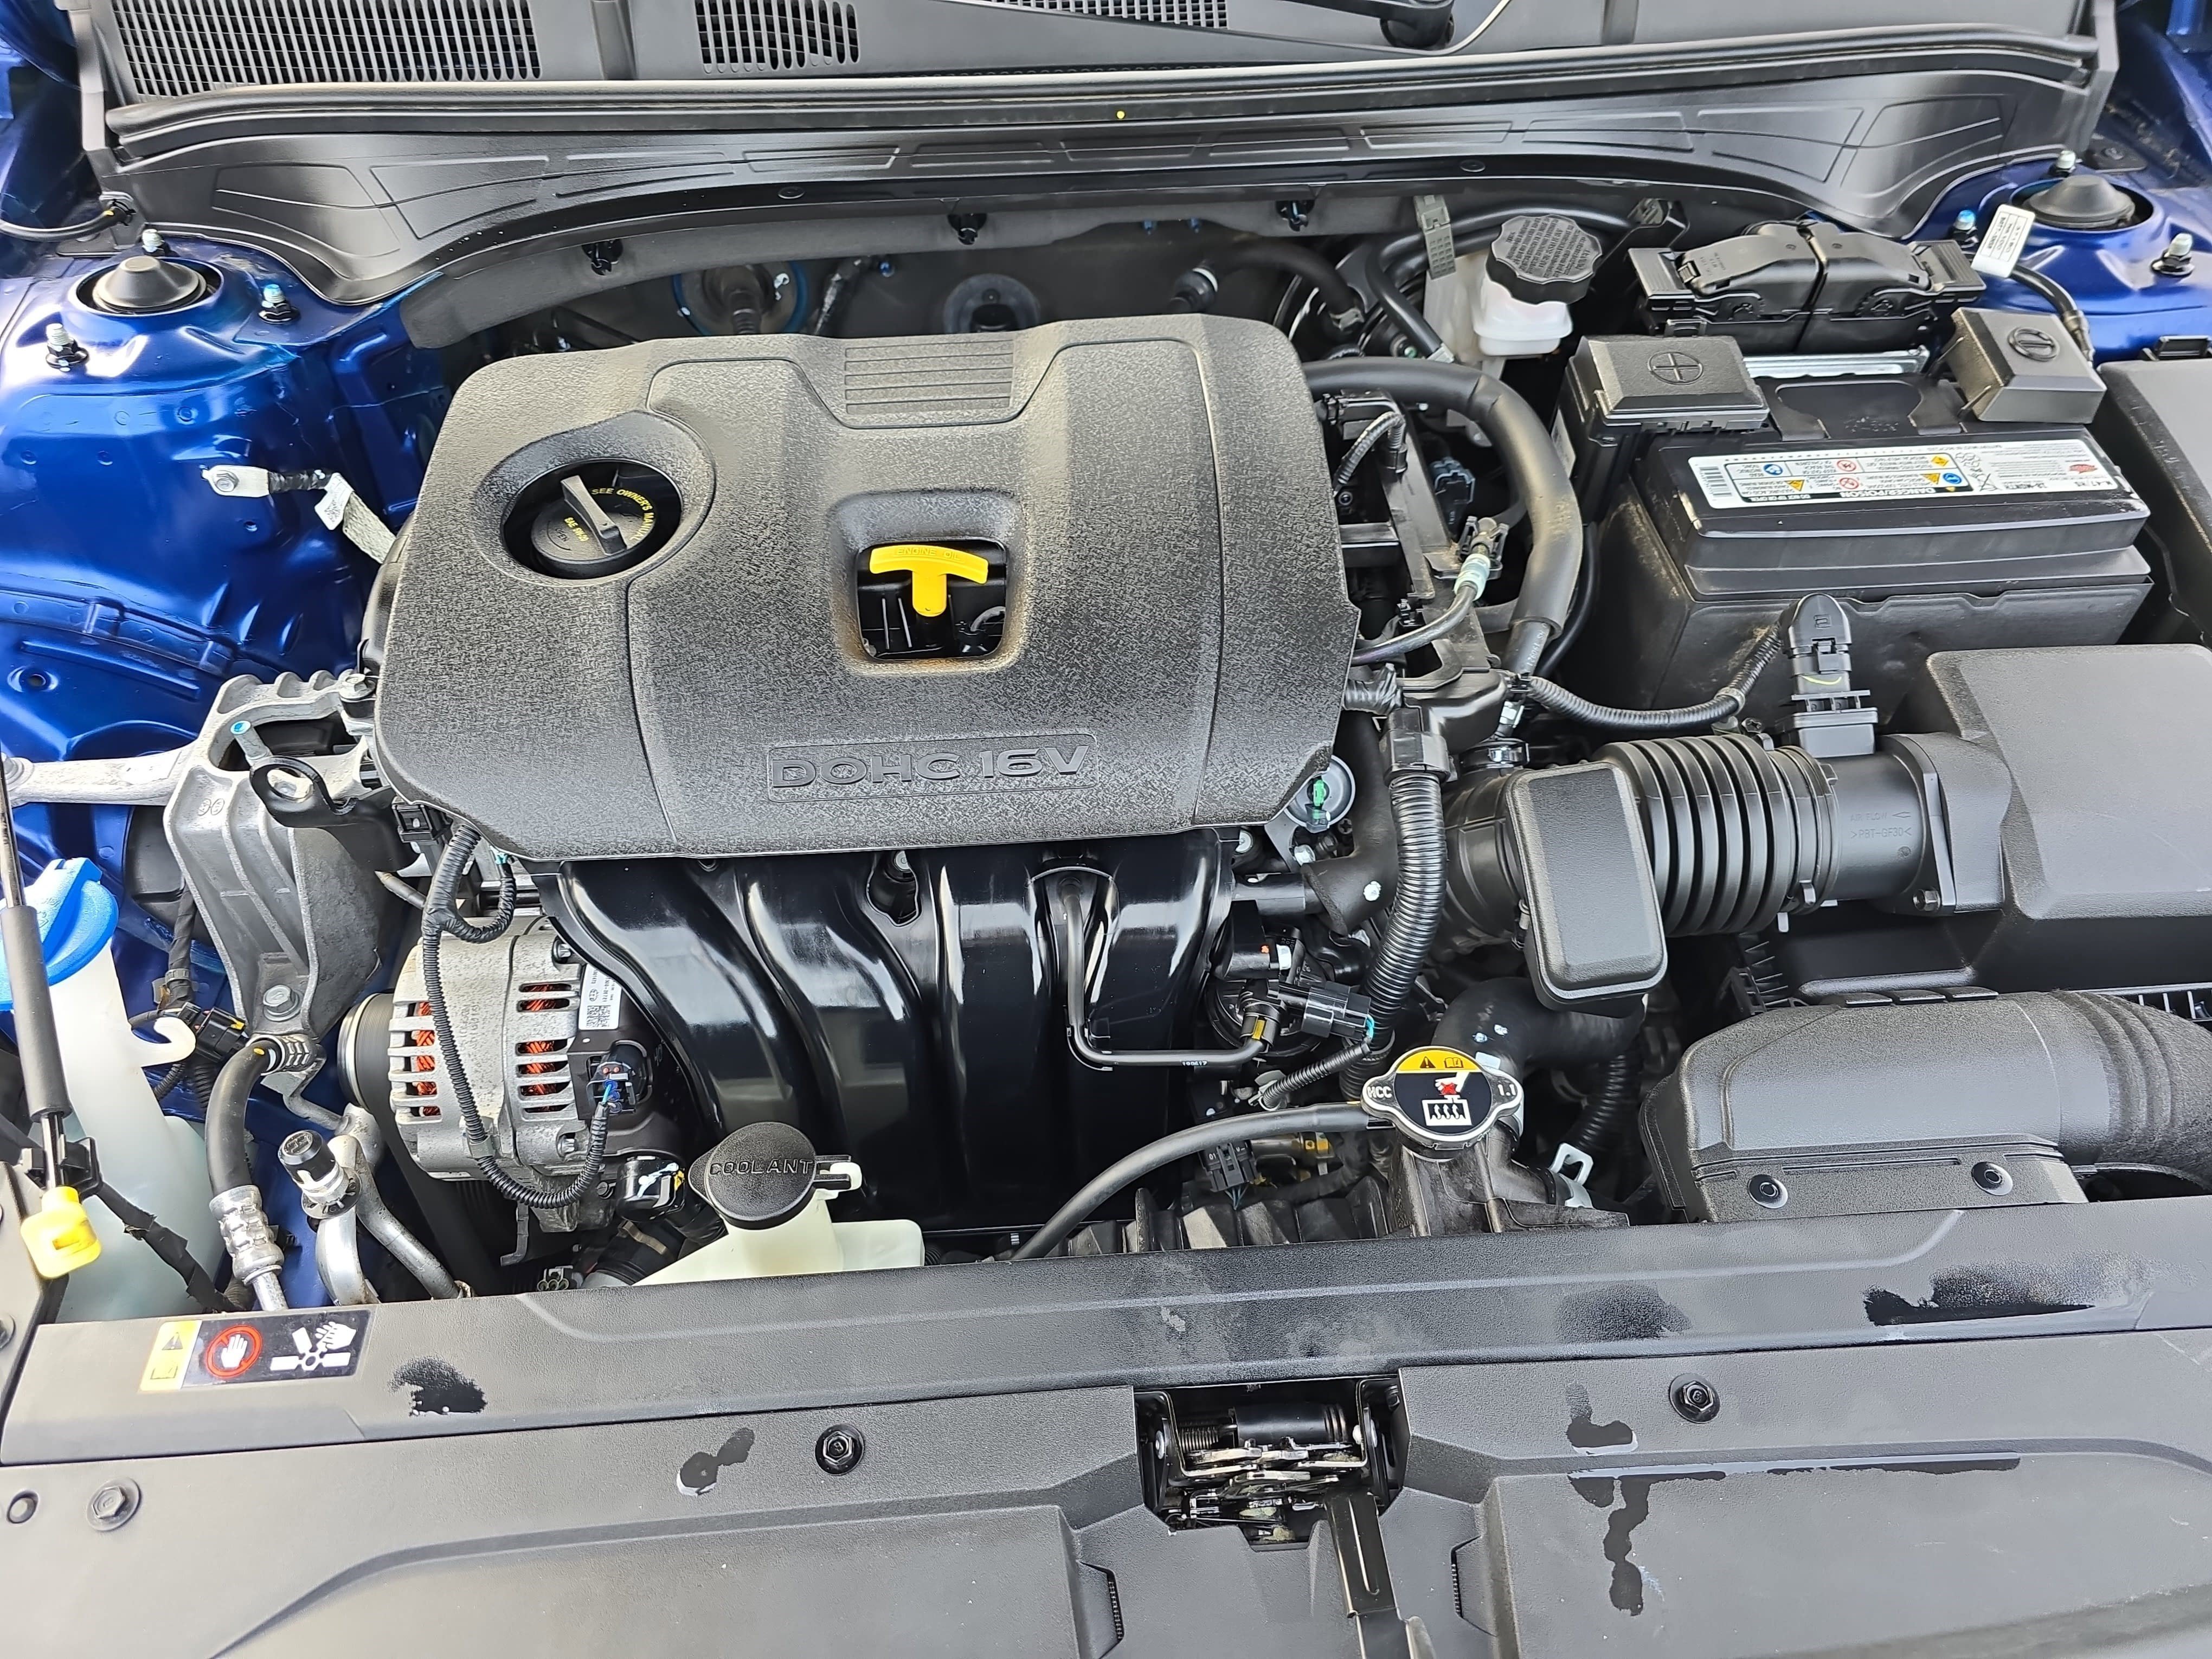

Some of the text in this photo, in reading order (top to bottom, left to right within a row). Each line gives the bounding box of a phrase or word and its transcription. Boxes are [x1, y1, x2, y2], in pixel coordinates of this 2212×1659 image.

[616, 488, 653, 511] OWNER'S
[1840, 488, 1936, 498] DANGER/POISON
[629, 512, 655, 541] MANUAL
[897, 548, 960, 560] ENGINE OIL
[772, 745, 1090, 788] DOHC 16V
[1866, 812, 1887, 820] FLOW
[1367, 1086, 1392, 1098] HCC
[1497, 1083, 1517, 1096] 1.1
[709, 1159, 814, 1175] COOLANT
